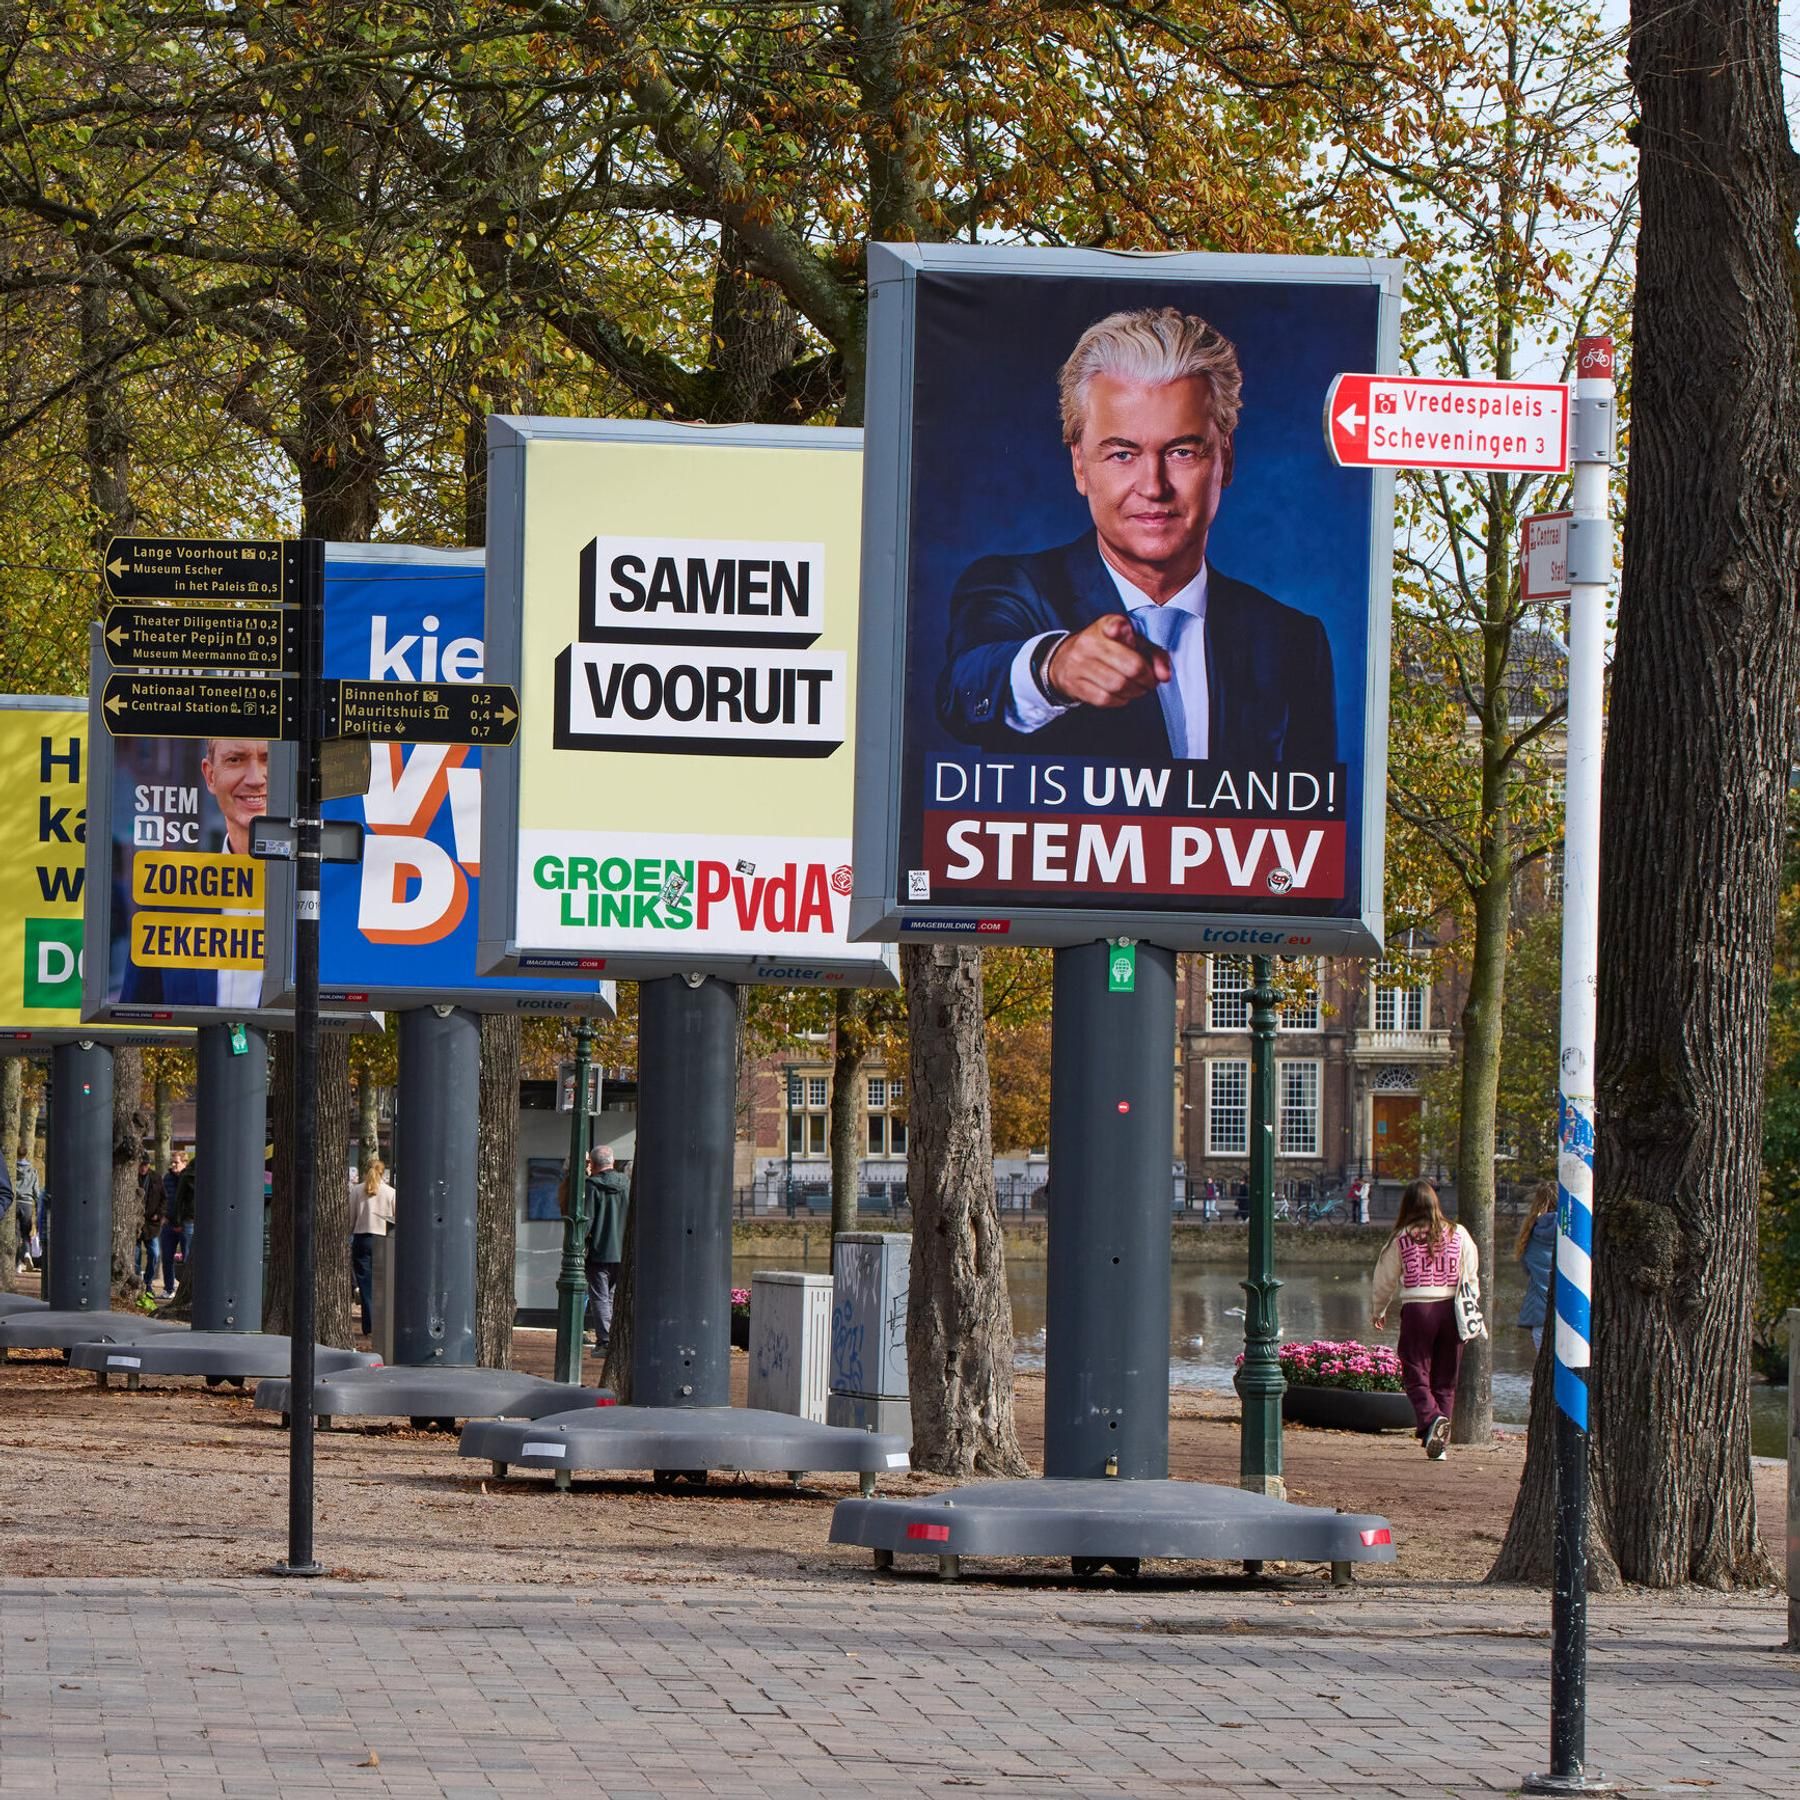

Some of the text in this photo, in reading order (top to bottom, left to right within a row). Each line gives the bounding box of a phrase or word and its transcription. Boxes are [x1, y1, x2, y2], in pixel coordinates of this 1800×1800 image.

[1403, 390, 1542, 419] Vredespaleis
[1373, 425, 1545, 458] Scheveningen 3
[1536, 525, 1561, 547] Centraal
[134, 547, 278, 561] Lange Voorhout 0,2
[134, 564, 223, 575] Museum Escher
[175, 581, 277, 593] in het Paleis 0,5
[609, 555, 810, 617] SAMEN
[133, 616, 277, 630] Theater Diligentia 0,2
[133, 631, 277, 646] Theater Pepijn 0,9
[369, 615, 484, 684] kie
[133, 648, 277, 662] Museum Meermanno 0,9
[132, 684, 276, 698] Nationaal Toneel 0,6
[345, 688, 491, 705] Binnenhof 0,2
[584, 662, 833, 725] VOORUIT
[131, 701, 277, 714] Centraal Station 1,2
[345, 704, 490, 722] Mauritshuis 0,4
[345, 720, 490, 737] Politie 0,7
[40, 737, 80, 783] H
[935, 762, 1336, 812] DIT IS UW LAND!
[134, 785, 199, 814] STEM
[135, 817, 199, 844] nsc
[945, 819, 1147, 885] STEM
[1170, 826, 1325, 888] PVV
[143, 864, 254, 897] ZORGEN
[533, 855, 695, 893] GROEN
[696, 860, 835, 934] PvdA
[560, 893, 693, 930] LINKS
[911, 921, 976, 930] IMAGEBUILDING
[1203, 927, 1312, 945] trotter.eu
[142, 925, 265, 959] ZEKERHE
[38, 941, 83, 983] D
[526, 959, 578, 967] IMAGEBUILDING
[1405, 1256, 1457, 1273] CLUB
[1463, 1300, 1479, 1316] P
